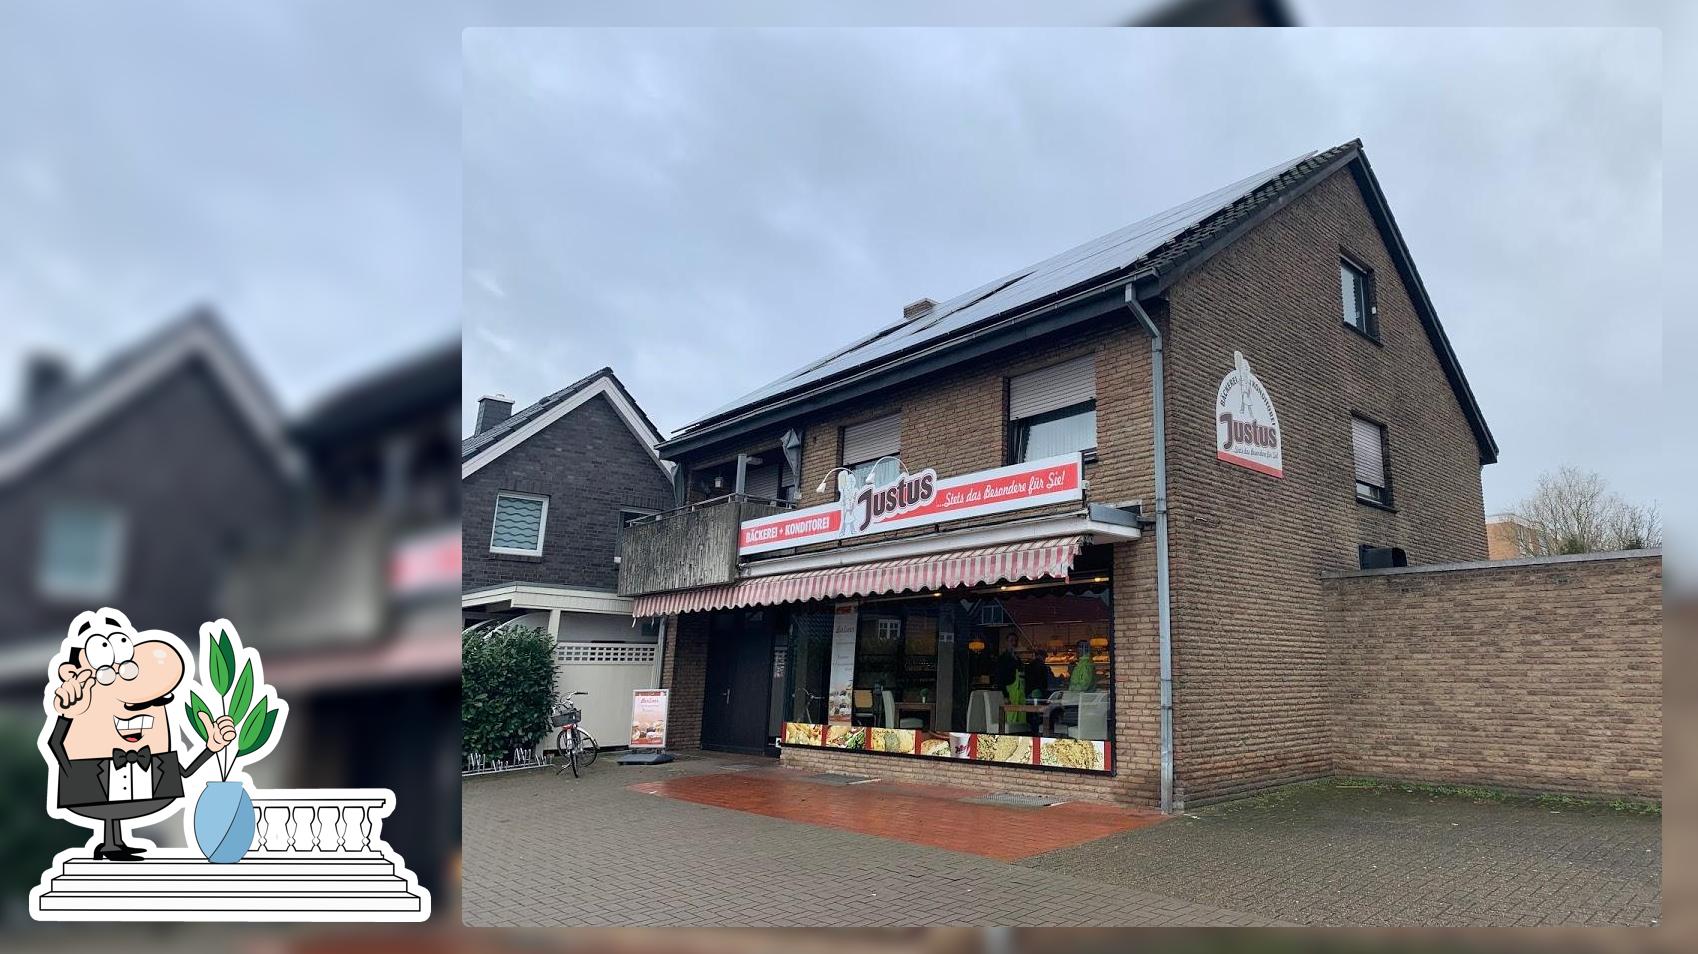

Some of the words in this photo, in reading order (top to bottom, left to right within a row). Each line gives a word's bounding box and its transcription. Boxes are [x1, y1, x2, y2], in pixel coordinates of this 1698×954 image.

[1219, 412, 1277, 450] Justus
[857, 474, 934, 532] Justus
[966, 489, 981, 503] das
[984, 480, 1027, 498] Besondere
[1028, 476, 1044, 494] für
[1046, 470, 1066, 488] Sie!
[745, 526, 778, 544] BÄCKEREI
[784, 516, 830, 536] KONDITOREI
